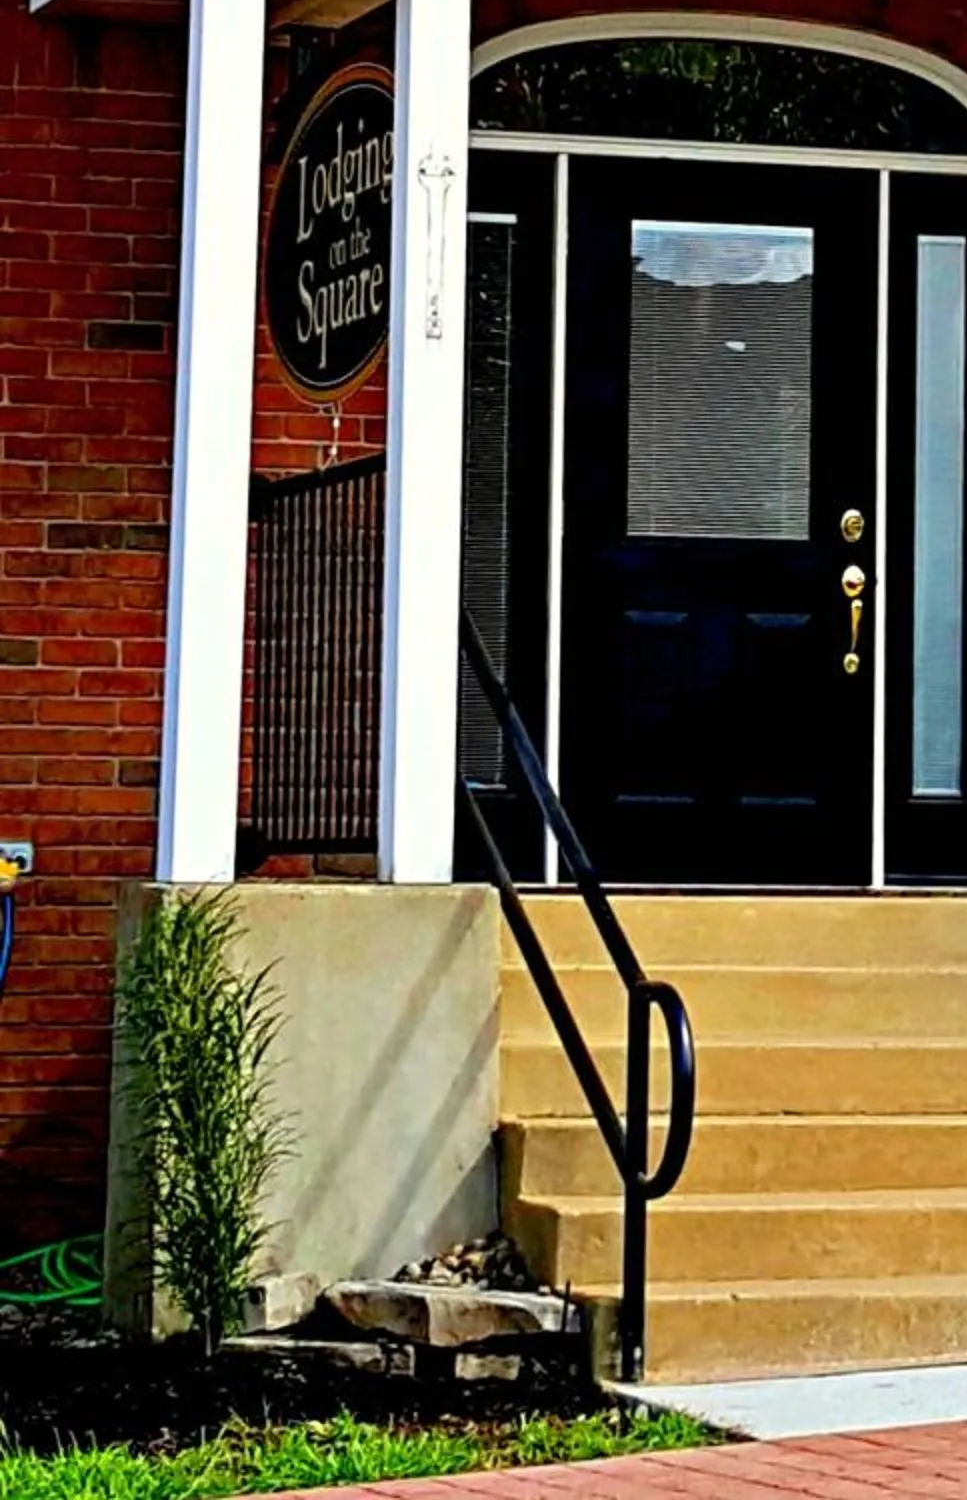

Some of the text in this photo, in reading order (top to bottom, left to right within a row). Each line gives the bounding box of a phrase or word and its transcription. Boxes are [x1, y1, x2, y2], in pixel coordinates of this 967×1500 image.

[296, 117, 394, 244] Lodging
[328, 216, 371, 270] on the
[297, 260, 383, 369] Square
